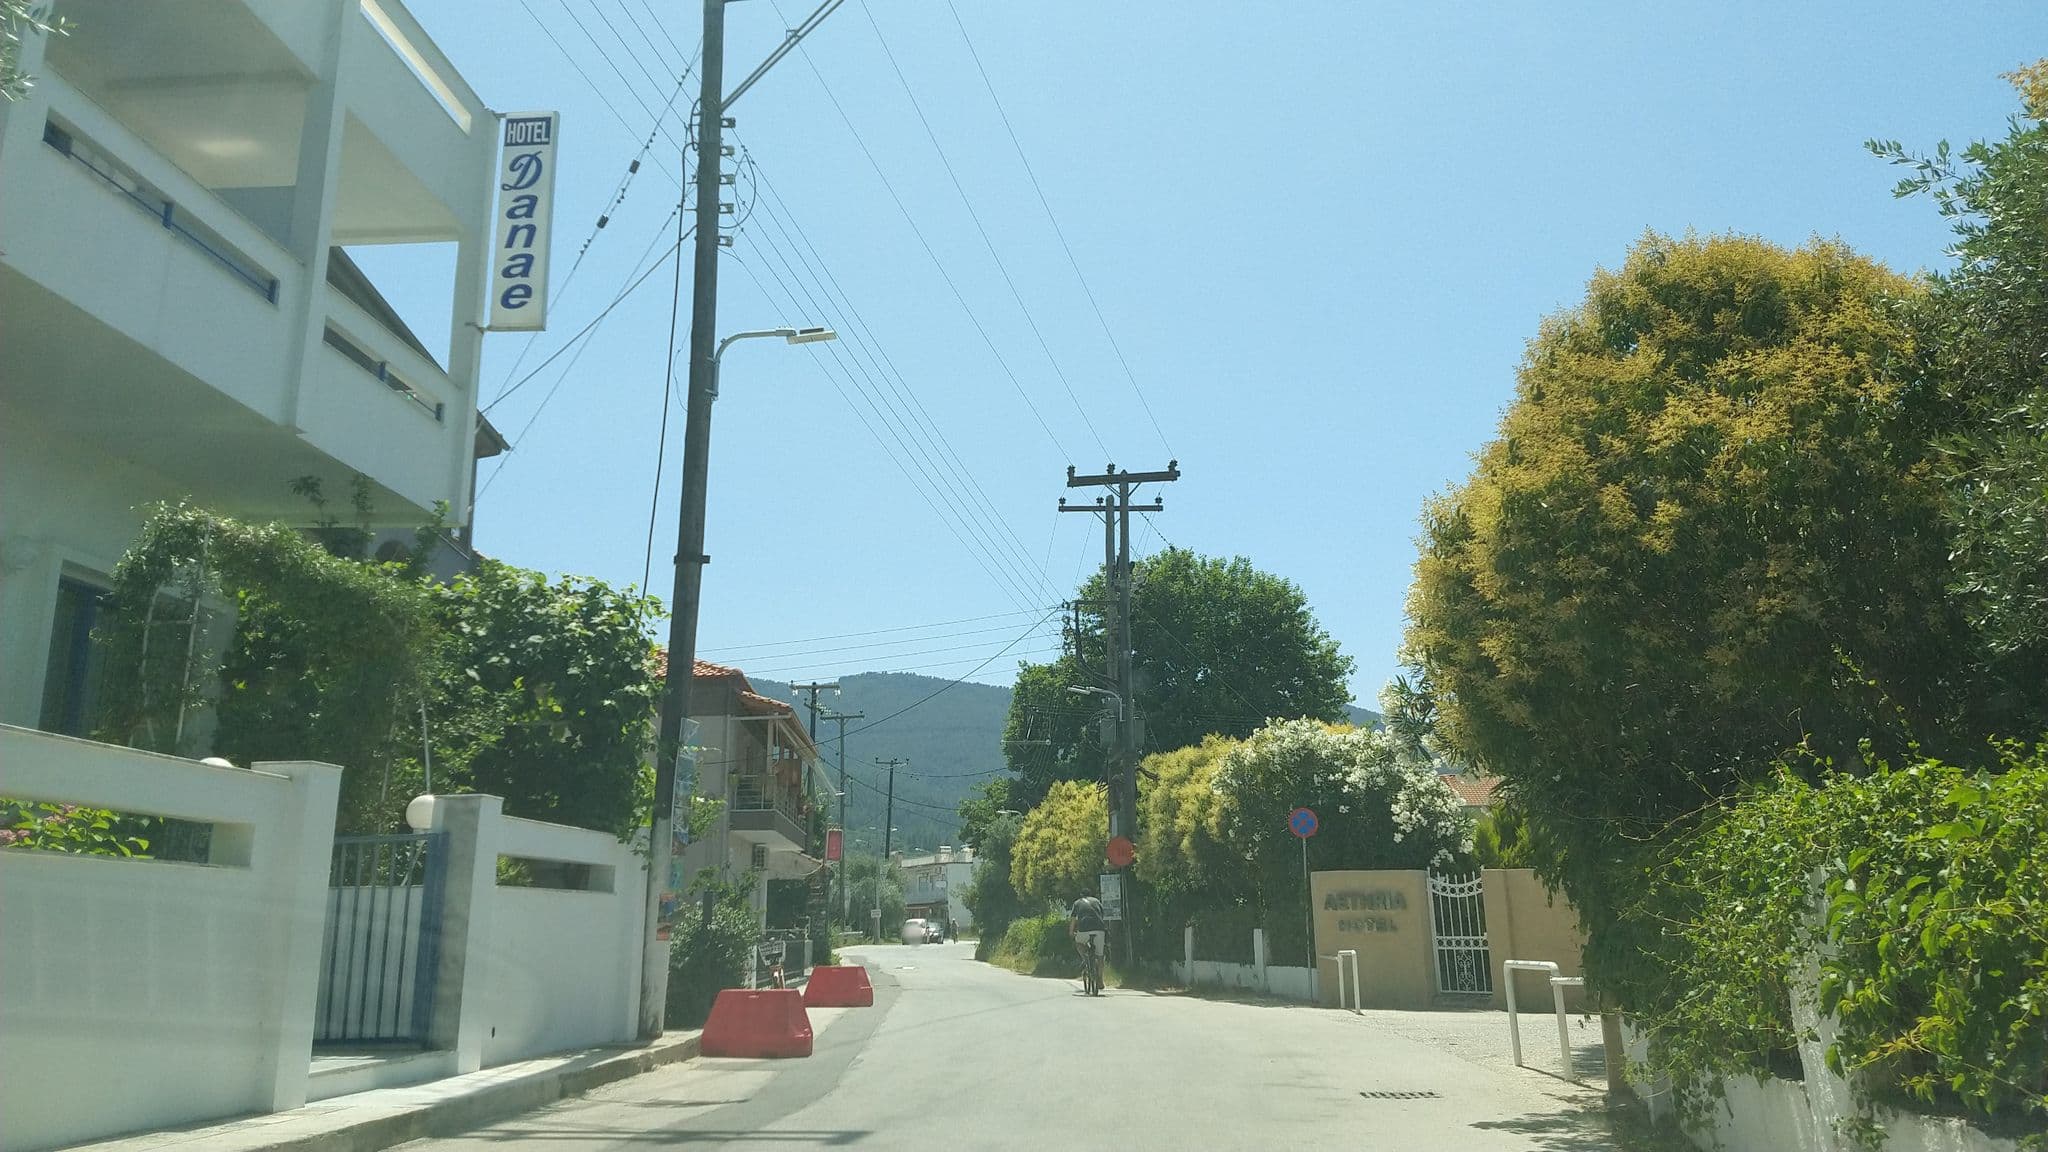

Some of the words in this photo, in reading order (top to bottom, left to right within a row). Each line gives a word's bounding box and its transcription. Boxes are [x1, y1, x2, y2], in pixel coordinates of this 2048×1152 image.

[506, 121, 550, 144] HOTEL
[501, 151, 543, 310] Danae
[1338, 918, 1398, 932] HOTEL
